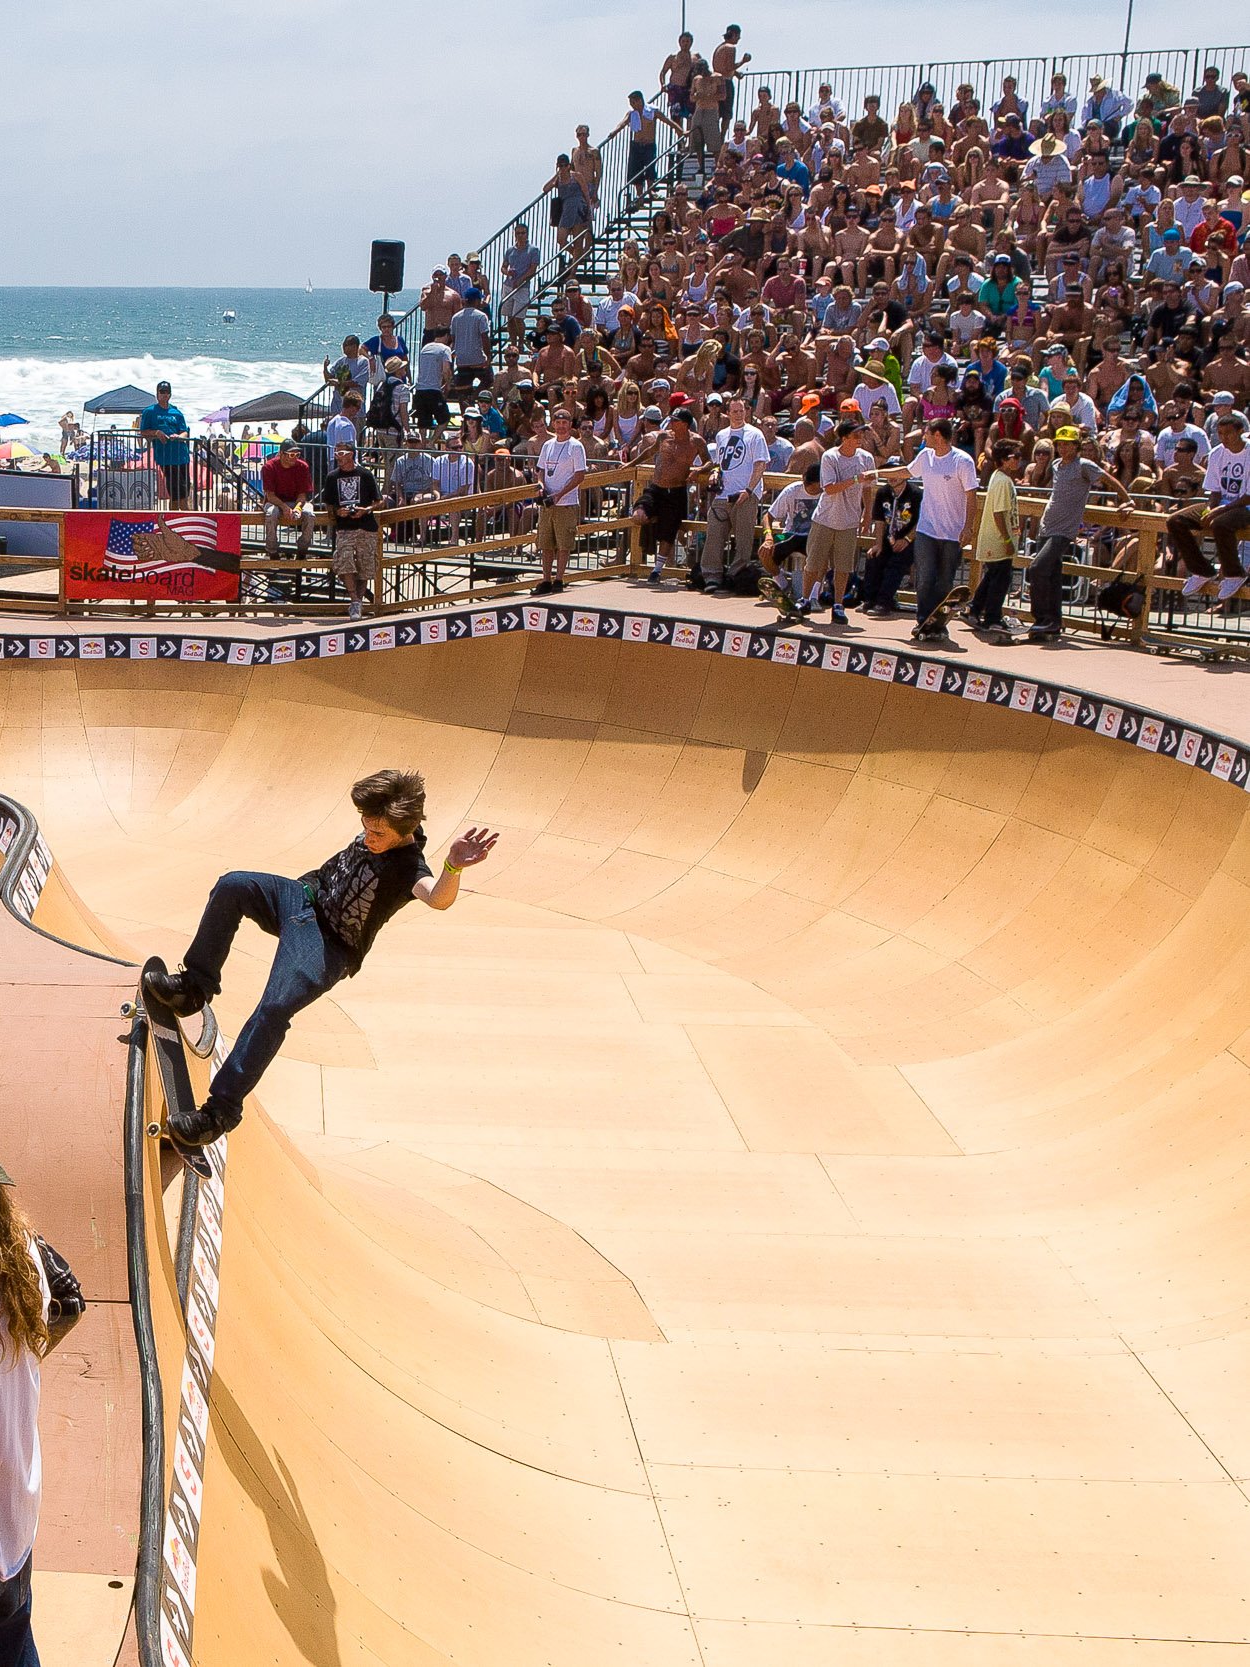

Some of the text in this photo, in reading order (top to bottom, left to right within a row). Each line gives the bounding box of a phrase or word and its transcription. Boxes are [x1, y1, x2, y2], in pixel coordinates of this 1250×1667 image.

[70, 563, 194, 587] skateboard
[166, 585, 194, 596] MAG
[529, 612, 540, 626] S
[430, 625, 438, 639] S
[632, 622, 642, 637] S
[39, 641, 47, 654] S
[139, 642, 149, 655] S
[328, 639, 337, 652] S
[732, 637, 743, 653] S
[237, 648, 247, 660] S
[831, 650, 841, 666] S
[926, 670, 937, 685] S
[1019, 688, 1029, 706] S
[1105, 713, 1116, 730] S
[1185, 739, 1194, 758] S
